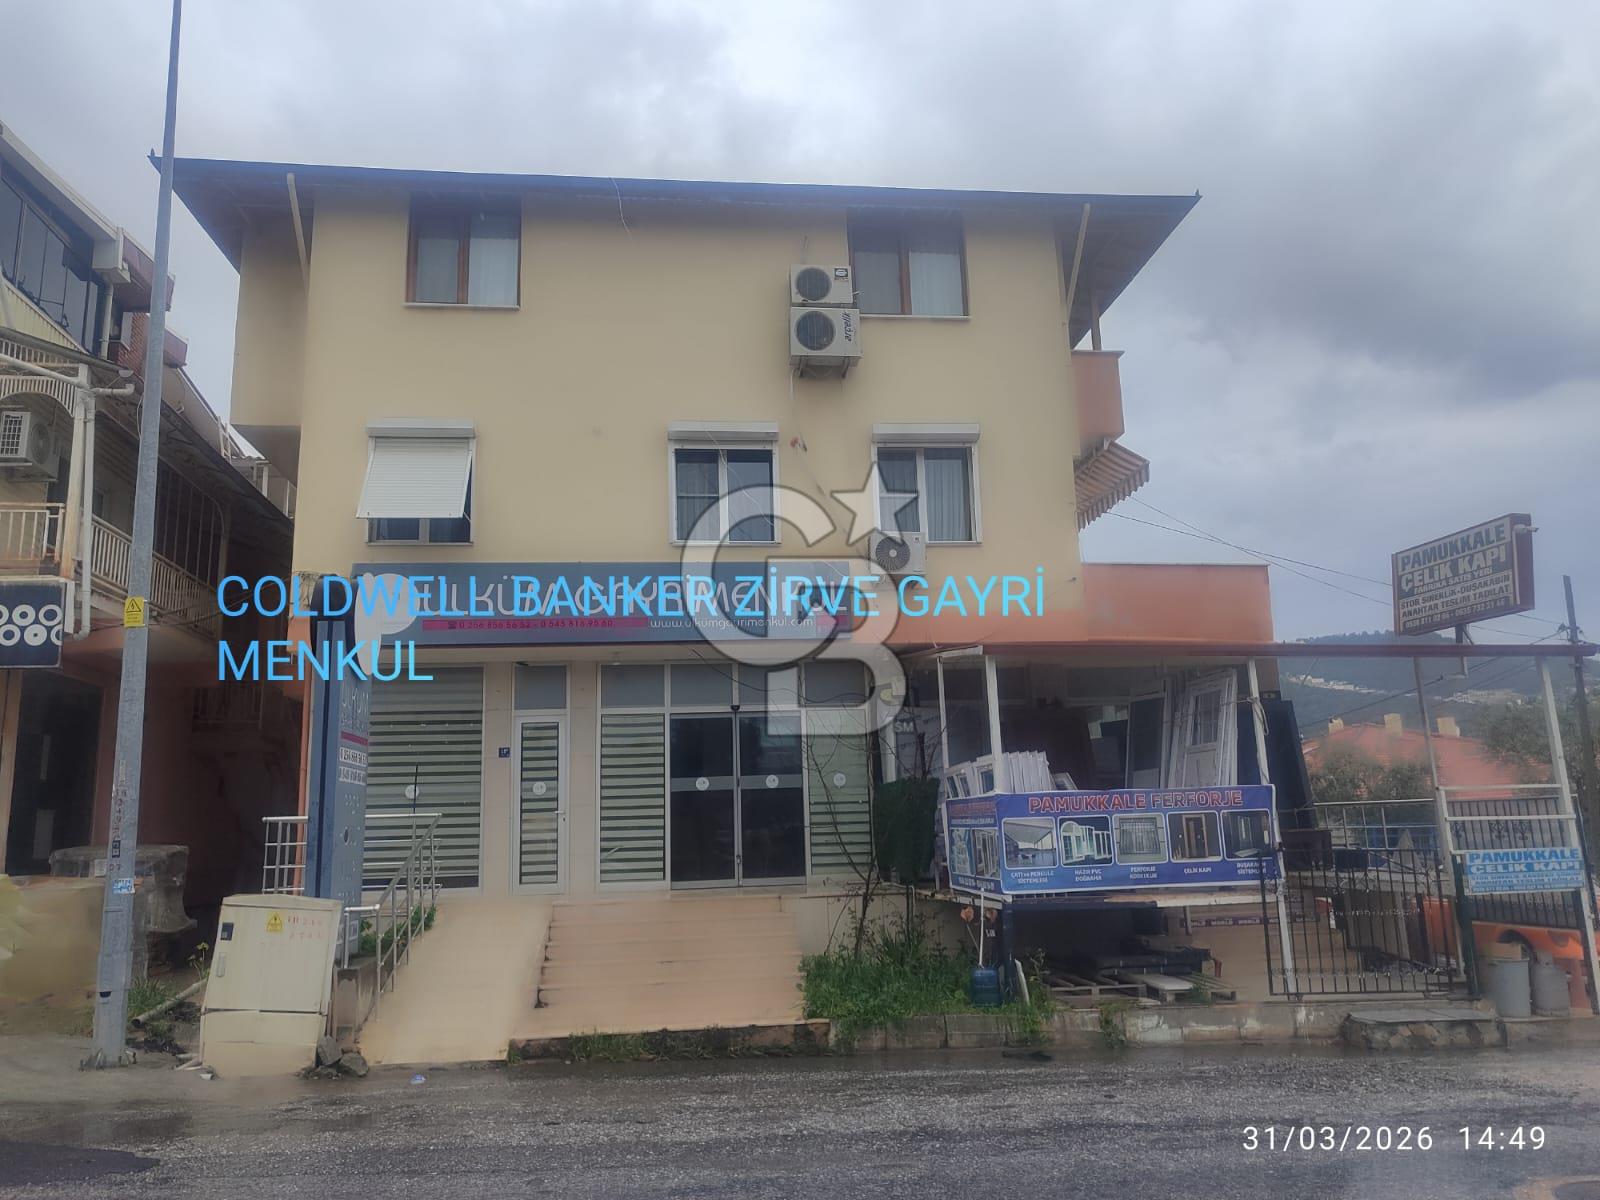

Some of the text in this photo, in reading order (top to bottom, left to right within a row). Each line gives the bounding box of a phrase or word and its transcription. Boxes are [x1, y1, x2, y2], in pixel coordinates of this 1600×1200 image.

[1401, 523, 1506, 571] PAMUKKALE
[1458, 545, 1506, 574] KAPI
[1029, 790, 1243, 813] PAMUKKALE FERFORJE
[1469, 848, 1580, 863] PAMUKKALE
[1533, 861, 1580, 871] KAPI
